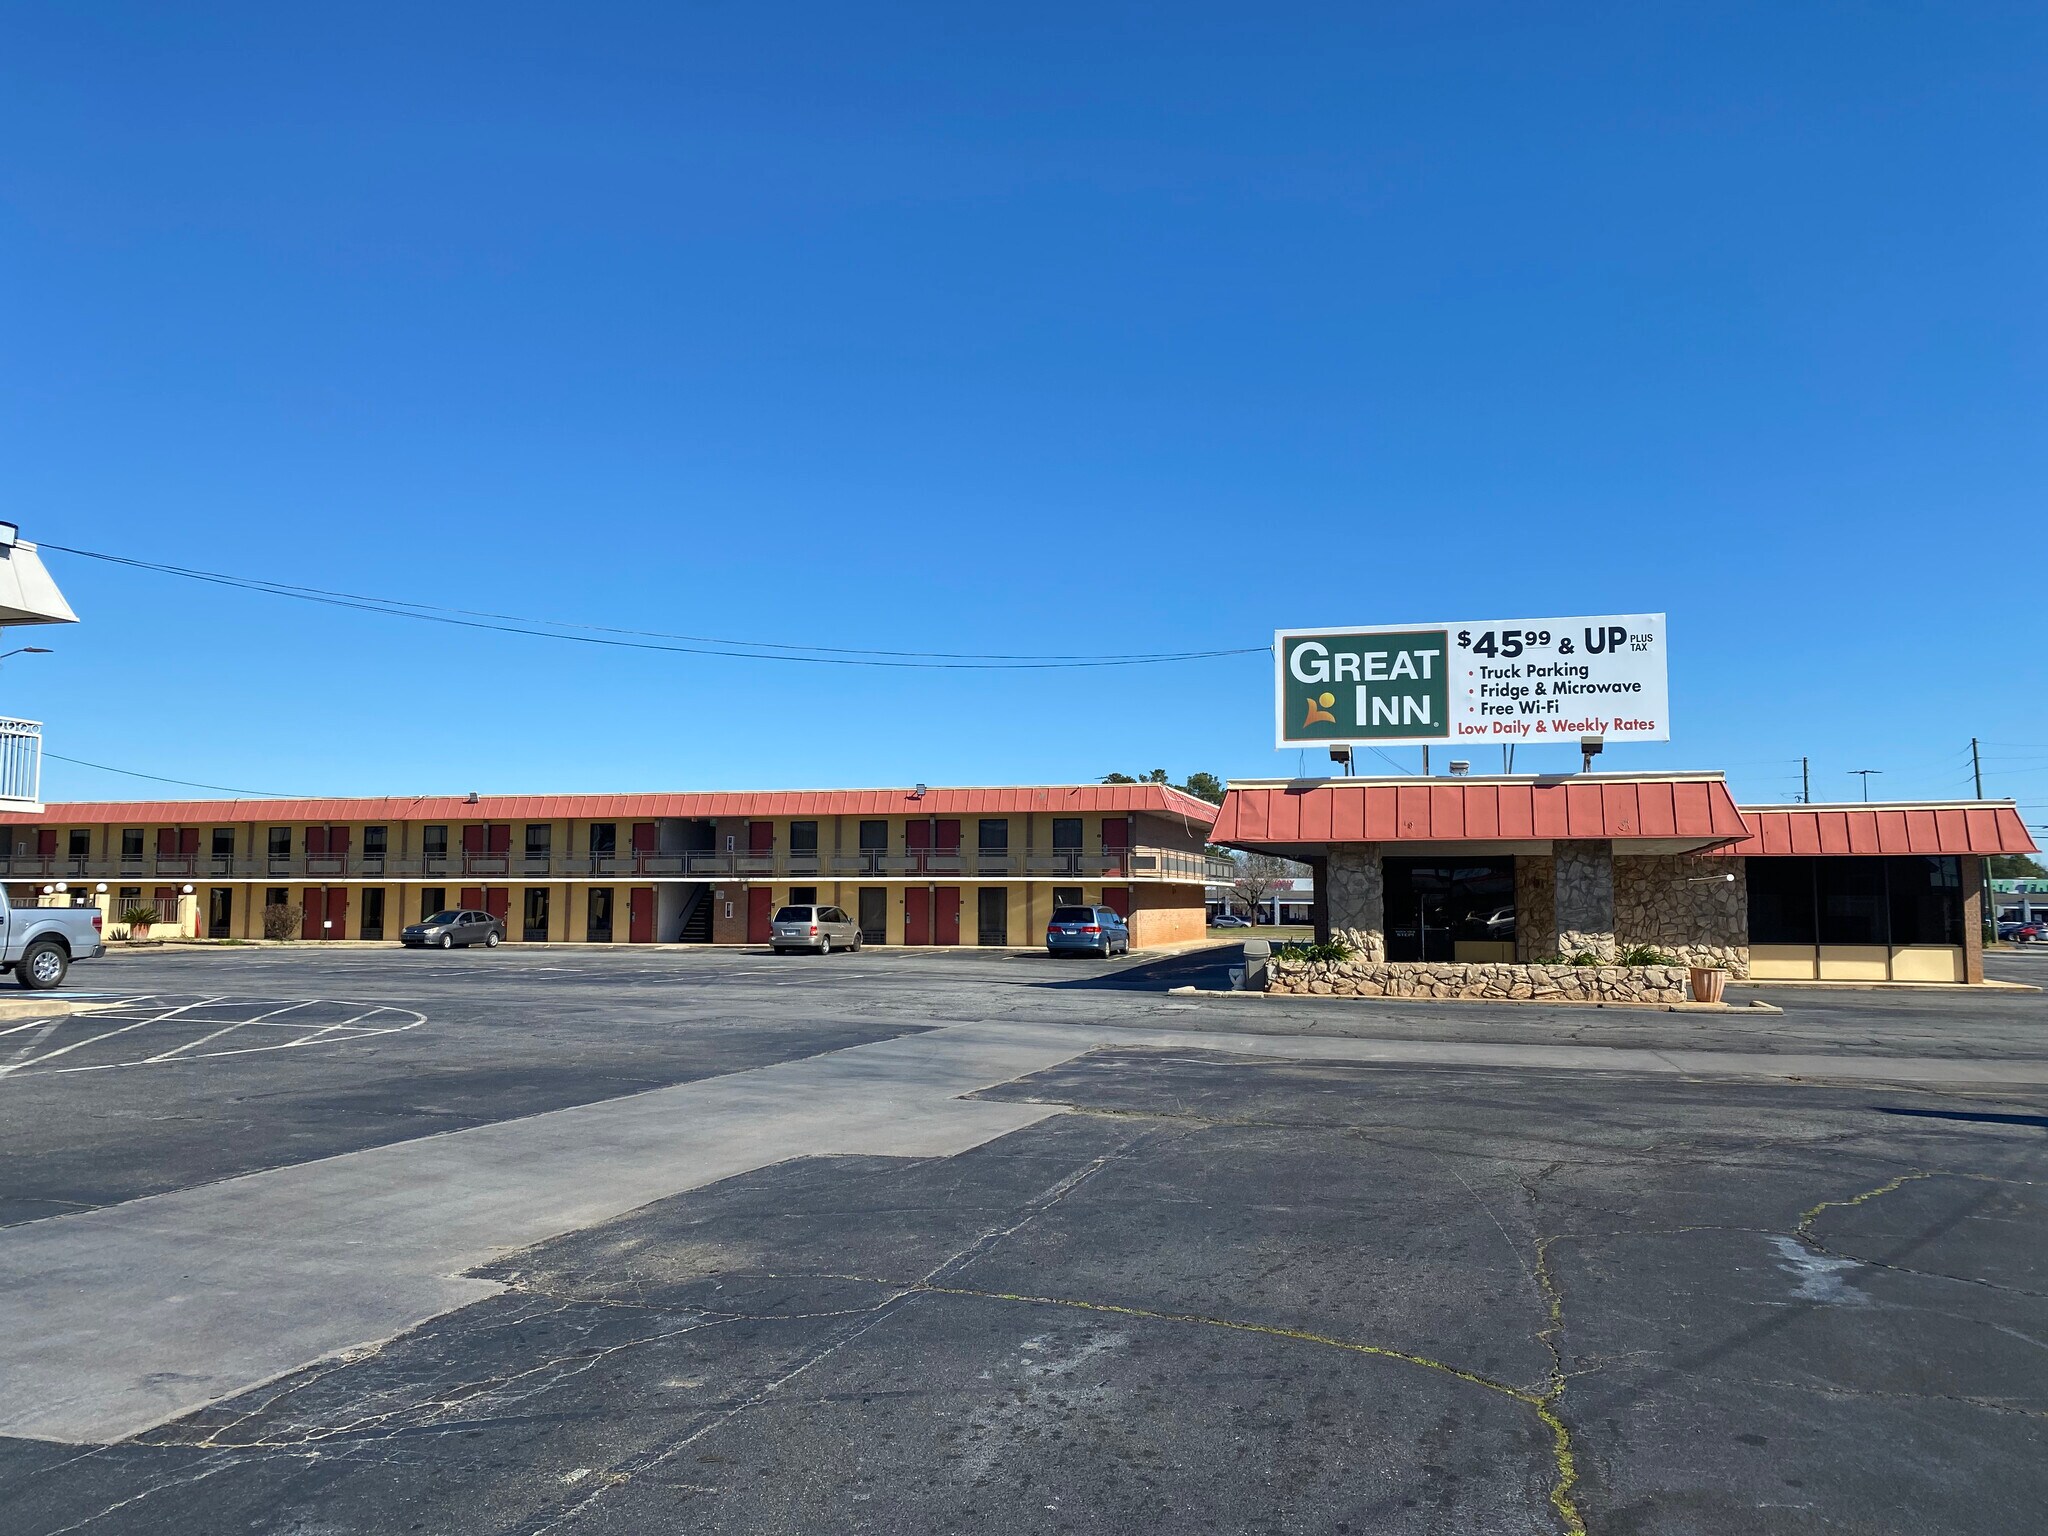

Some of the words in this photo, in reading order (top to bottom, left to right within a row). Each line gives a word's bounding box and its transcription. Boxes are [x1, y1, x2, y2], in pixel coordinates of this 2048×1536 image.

[1558, 637, 1575, 655] &
[1584, 626, 1628, 655] UP
[1630, 634, 1653, 643] PLUS
[1630, 643, 1648, 652] TAX
[1290, 641, 1440, 684] GREAT
[1479, 663, 1521, 679] Truck
[1526, 662, 1589, 680] Parking
[1480, 681, 1530, 700] Fridge
[1534, 681, 1547, 696] &
[1552, 680, 1641, 695] Microwave
[1355, 684, 1431, 726] INN
[1481, 702, 1514, 715] Free
[1519, 699, 1559, 714] Wi-Fi
[1458, 722, 1488, 735] Low
[1492, 719, 1531, 737] Daily
[1535, 719, 1547, 733] &
[1552, 717, 1609, 735] Weekly
[1614, 717, 1655, 731] Rates
